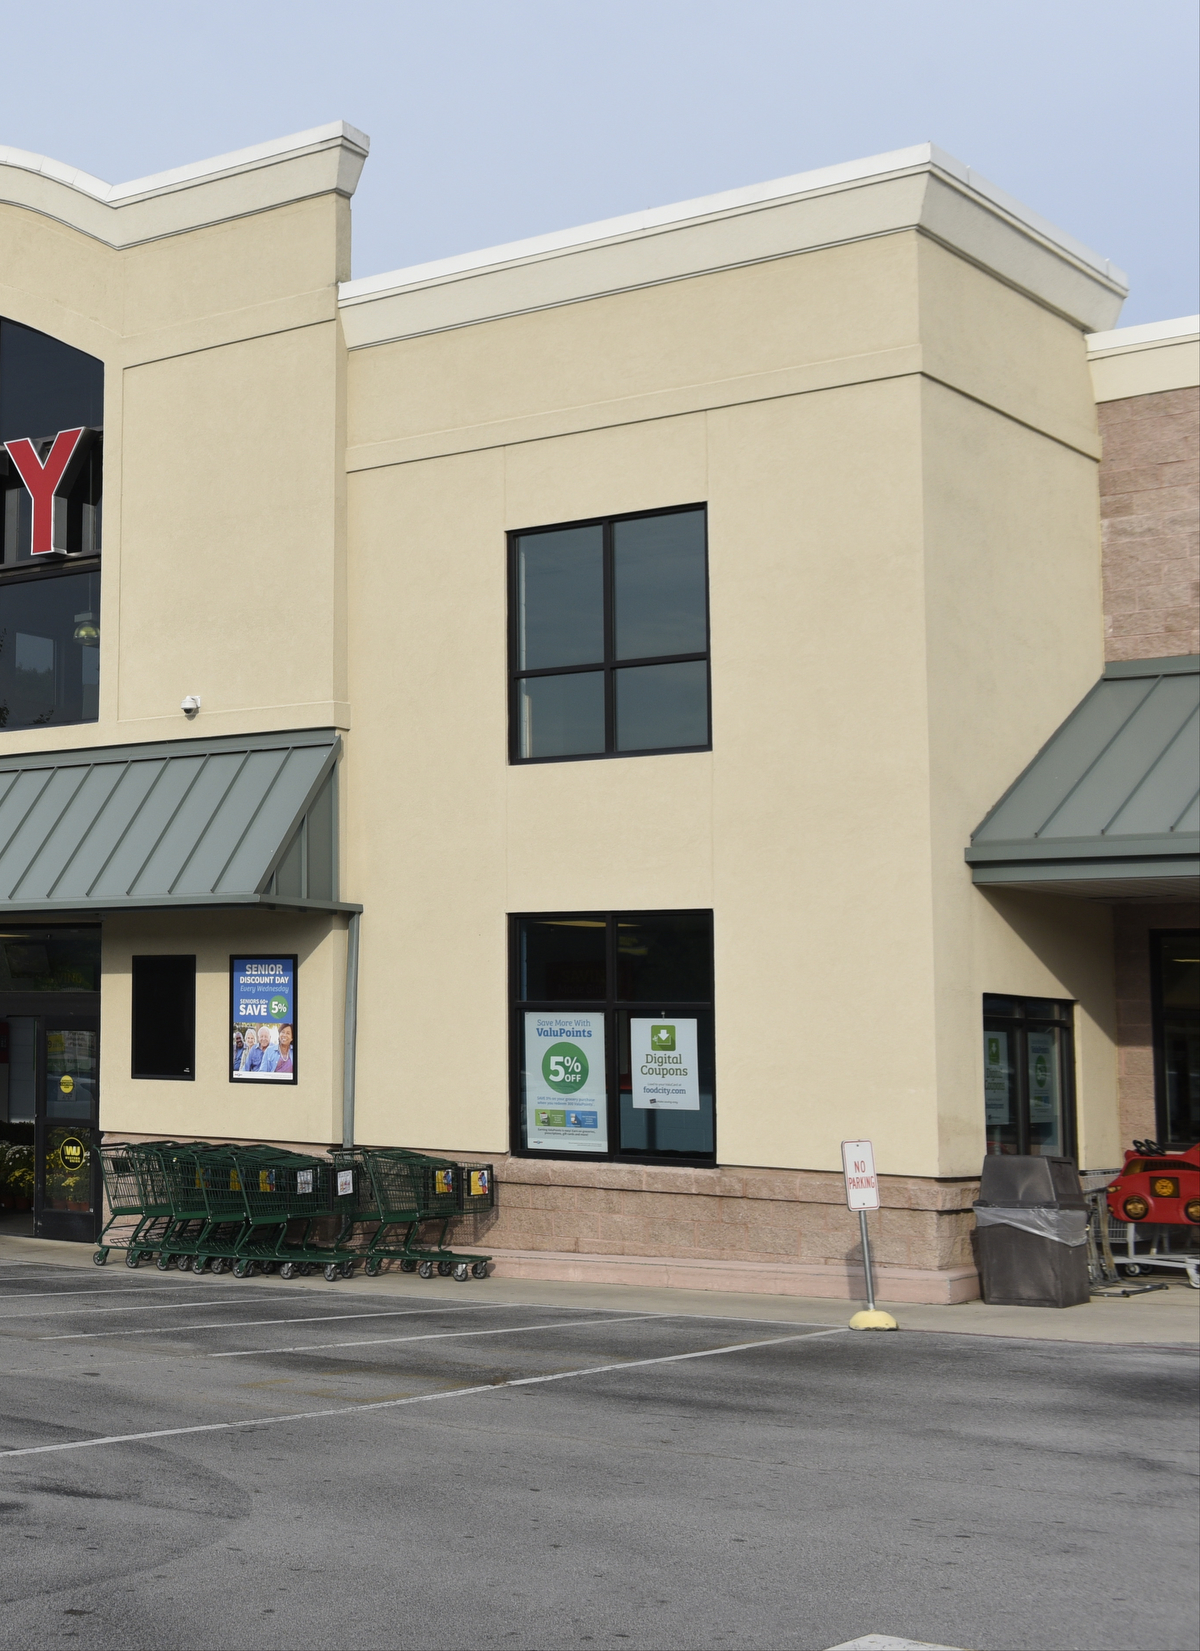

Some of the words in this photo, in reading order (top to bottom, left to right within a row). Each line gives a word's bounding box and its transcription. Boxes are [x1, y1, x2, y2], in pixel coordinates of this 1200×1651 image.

[245, 964, 283, 975] SENIOR
[239, 976, 274, 984] DISCOUNT
[275, 976, 289, 984] DAY
[240, 985, 256, 994] Every
[257, 985, 289, 994] Wednesday
[239, 1005, 267, 1016] SAVE
[271, 1001, 287, 1014] 5%
[537, 1019, 554, 1027] Save
[536, 1028, 592, 1038] ValuPoints
[645, 1053, 682, 1067] Digital
[549, 1056, 582, 1082] 5%
[640, 1065, 688, 1078] Coupons
[564, 1074, 581, 1082] OFF
[643, 1086, 686, 1095] foodcity.com
[63, 1145, 81, 1156] WU
[854, 1160, 866, 1173] NO
[848, 1176, 875, 1189] PARKING
